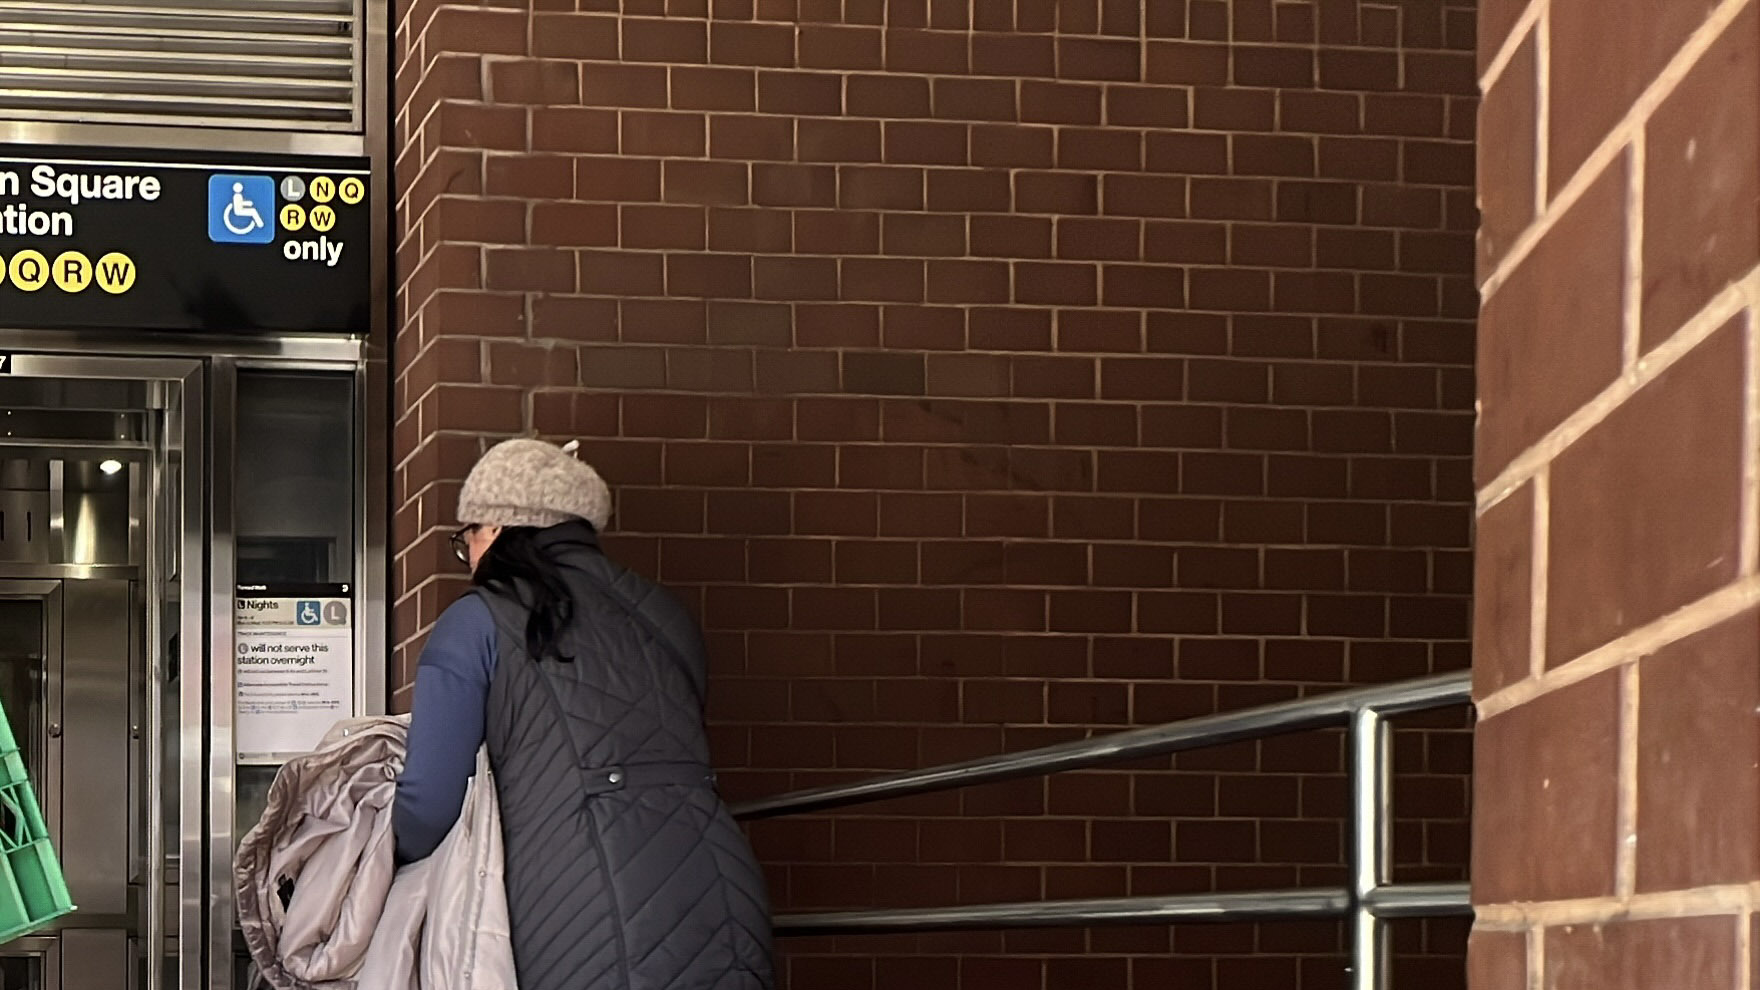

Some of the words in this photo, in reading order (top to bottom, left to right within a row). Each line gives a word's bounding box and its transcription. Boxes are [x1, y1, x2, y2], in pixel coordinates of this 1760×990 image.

[30, 164, 162, 206] Square
[283, 235, 344, 267] only
[246, 599, 279, 612] Nights
[250, 643, 266, 653] will
[267, 644, 283, 653] not
[283, 645, 311, 653] serve
[311, 643, 329, 653] this
[237, 655, 270, 665] station
[270, 654, 315, 667] overnight
